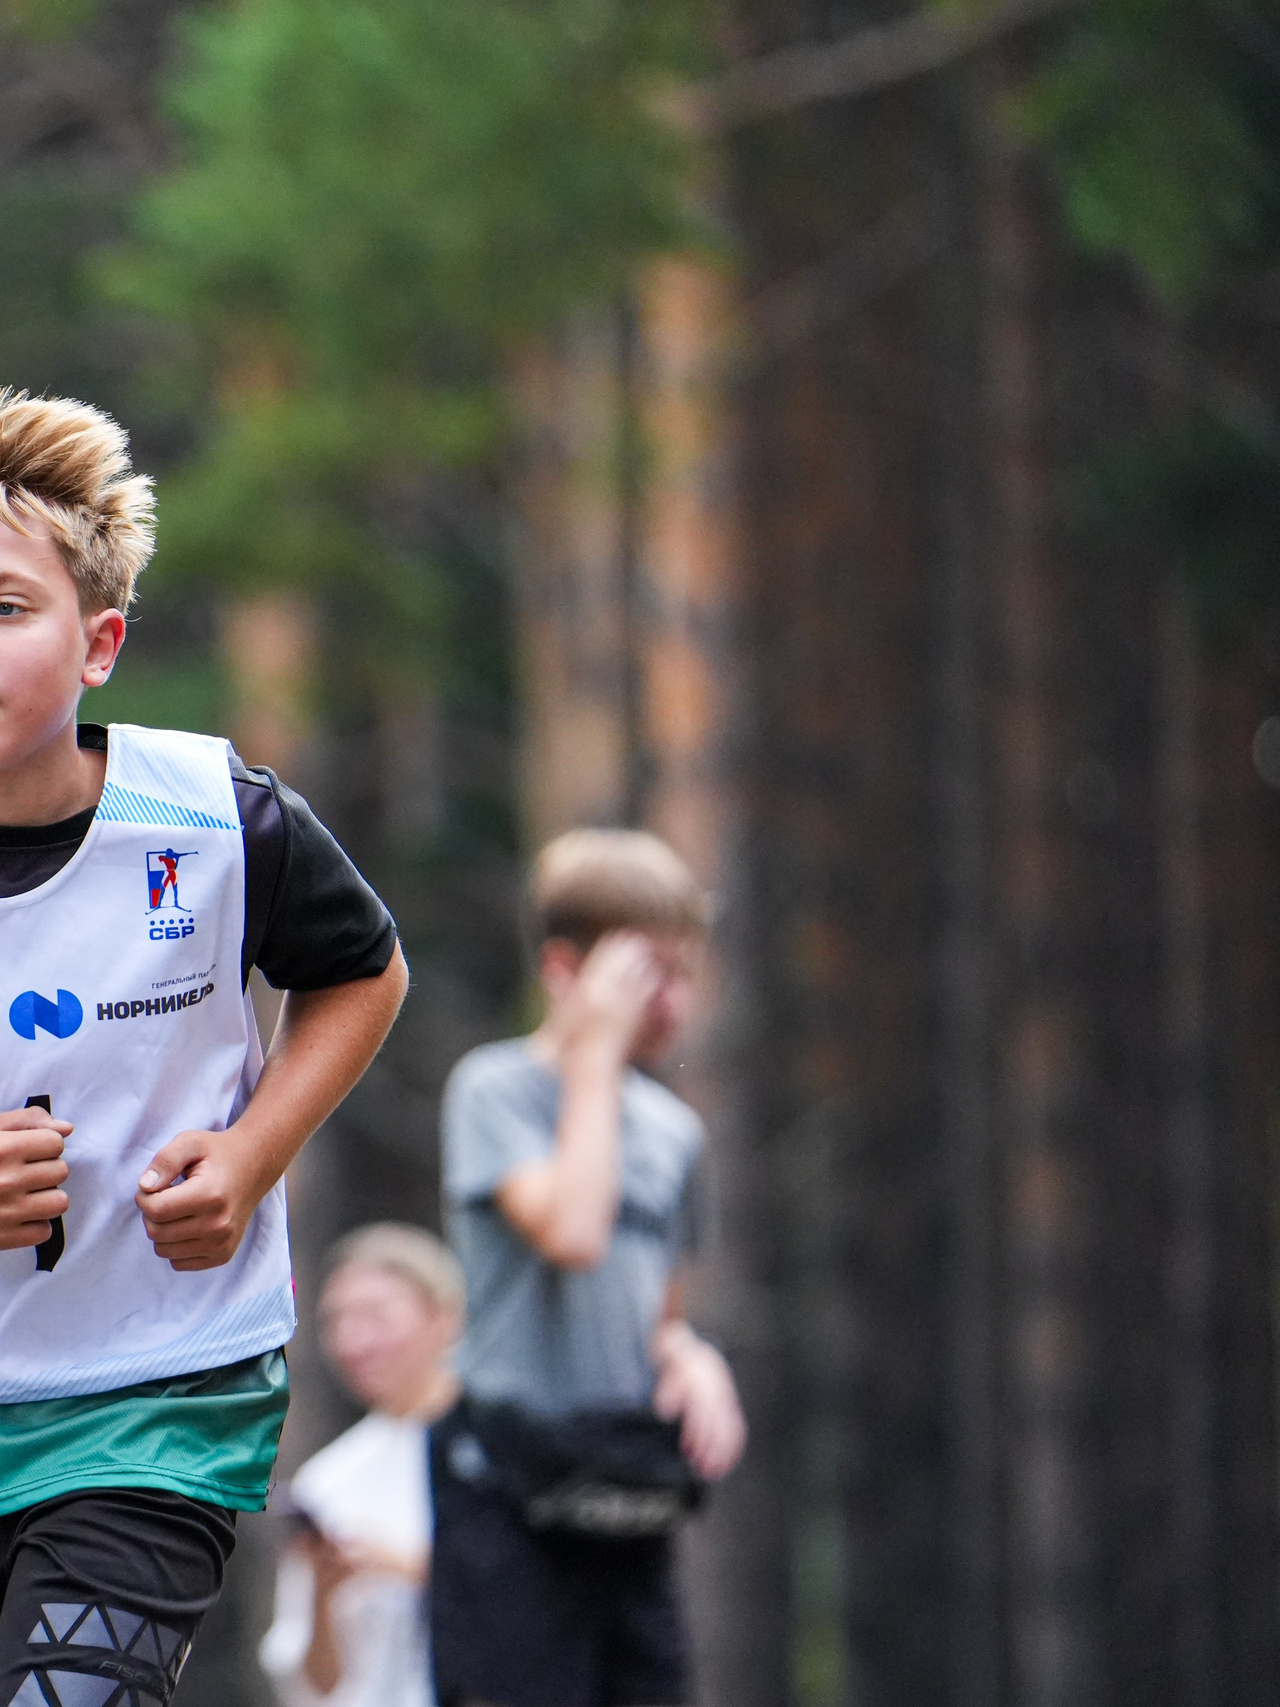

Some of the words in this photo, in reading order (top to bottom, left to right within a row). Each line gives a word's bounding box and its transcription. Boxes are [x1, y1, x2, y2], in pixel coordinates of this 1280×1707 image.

[149, 925, 195, 941] СБР
[151, 972, 197, 989] ГЕНЕРАЛЬНЫЙ
[96, 980, 215, 1021] НОРНИКЕЛЬ
